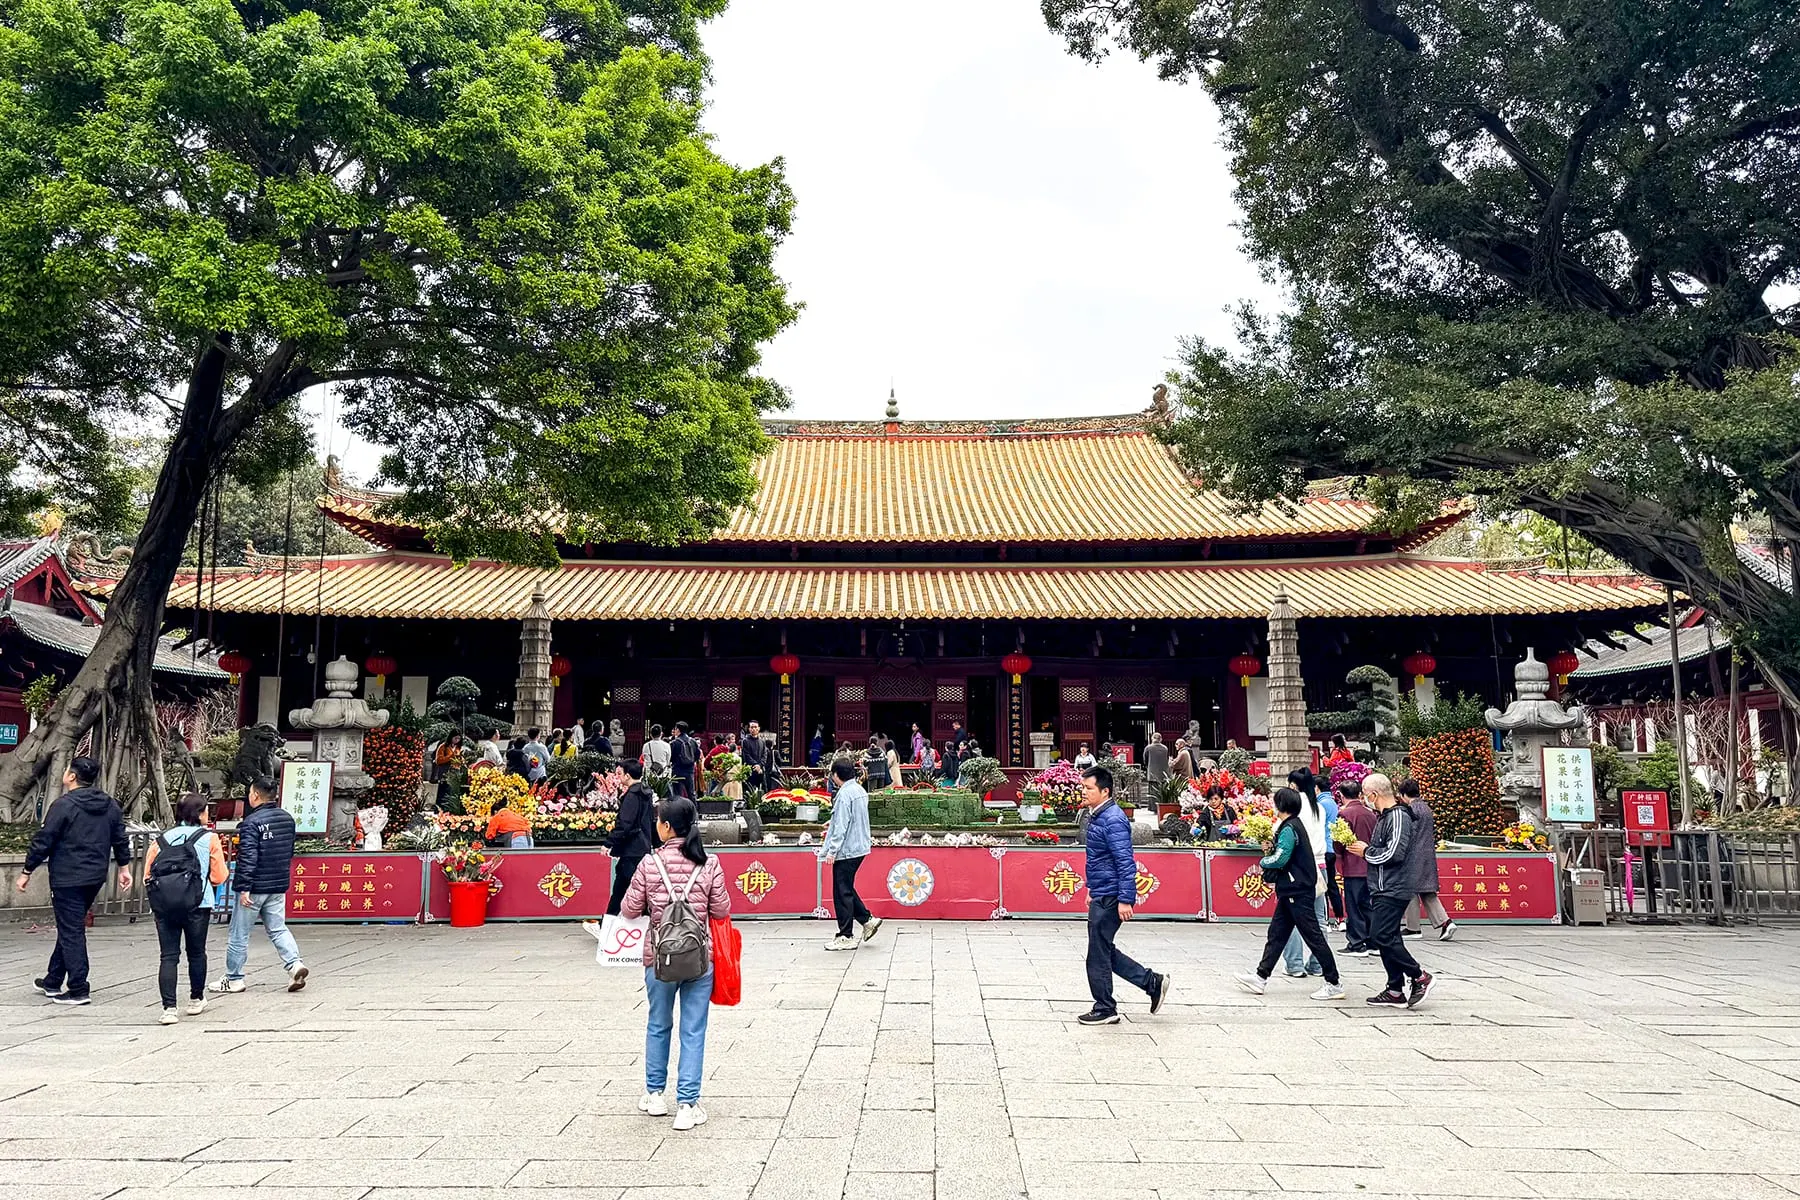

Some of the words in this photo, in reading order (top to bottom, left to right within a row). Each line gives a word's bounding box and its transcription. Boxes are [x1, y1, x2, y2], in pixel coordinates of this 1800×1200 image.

[295, 863, 376, 876] 合十问讯
[1451, 863, 1509, 876] 十问讯
[294, 880, 376, 893] 请勿跪地
[541, 871, 576, 898] 花
[737, 870, 774, 895] 佛
[1044, 869, 1081, 895] 请
[1236, 873, 1273, 900] 燃
[1452, 881, 1511, 894] 勿跪地
[293, 897, 374, 911] 鲜花供养
[1453, 898, 1511, 911] 花供养
